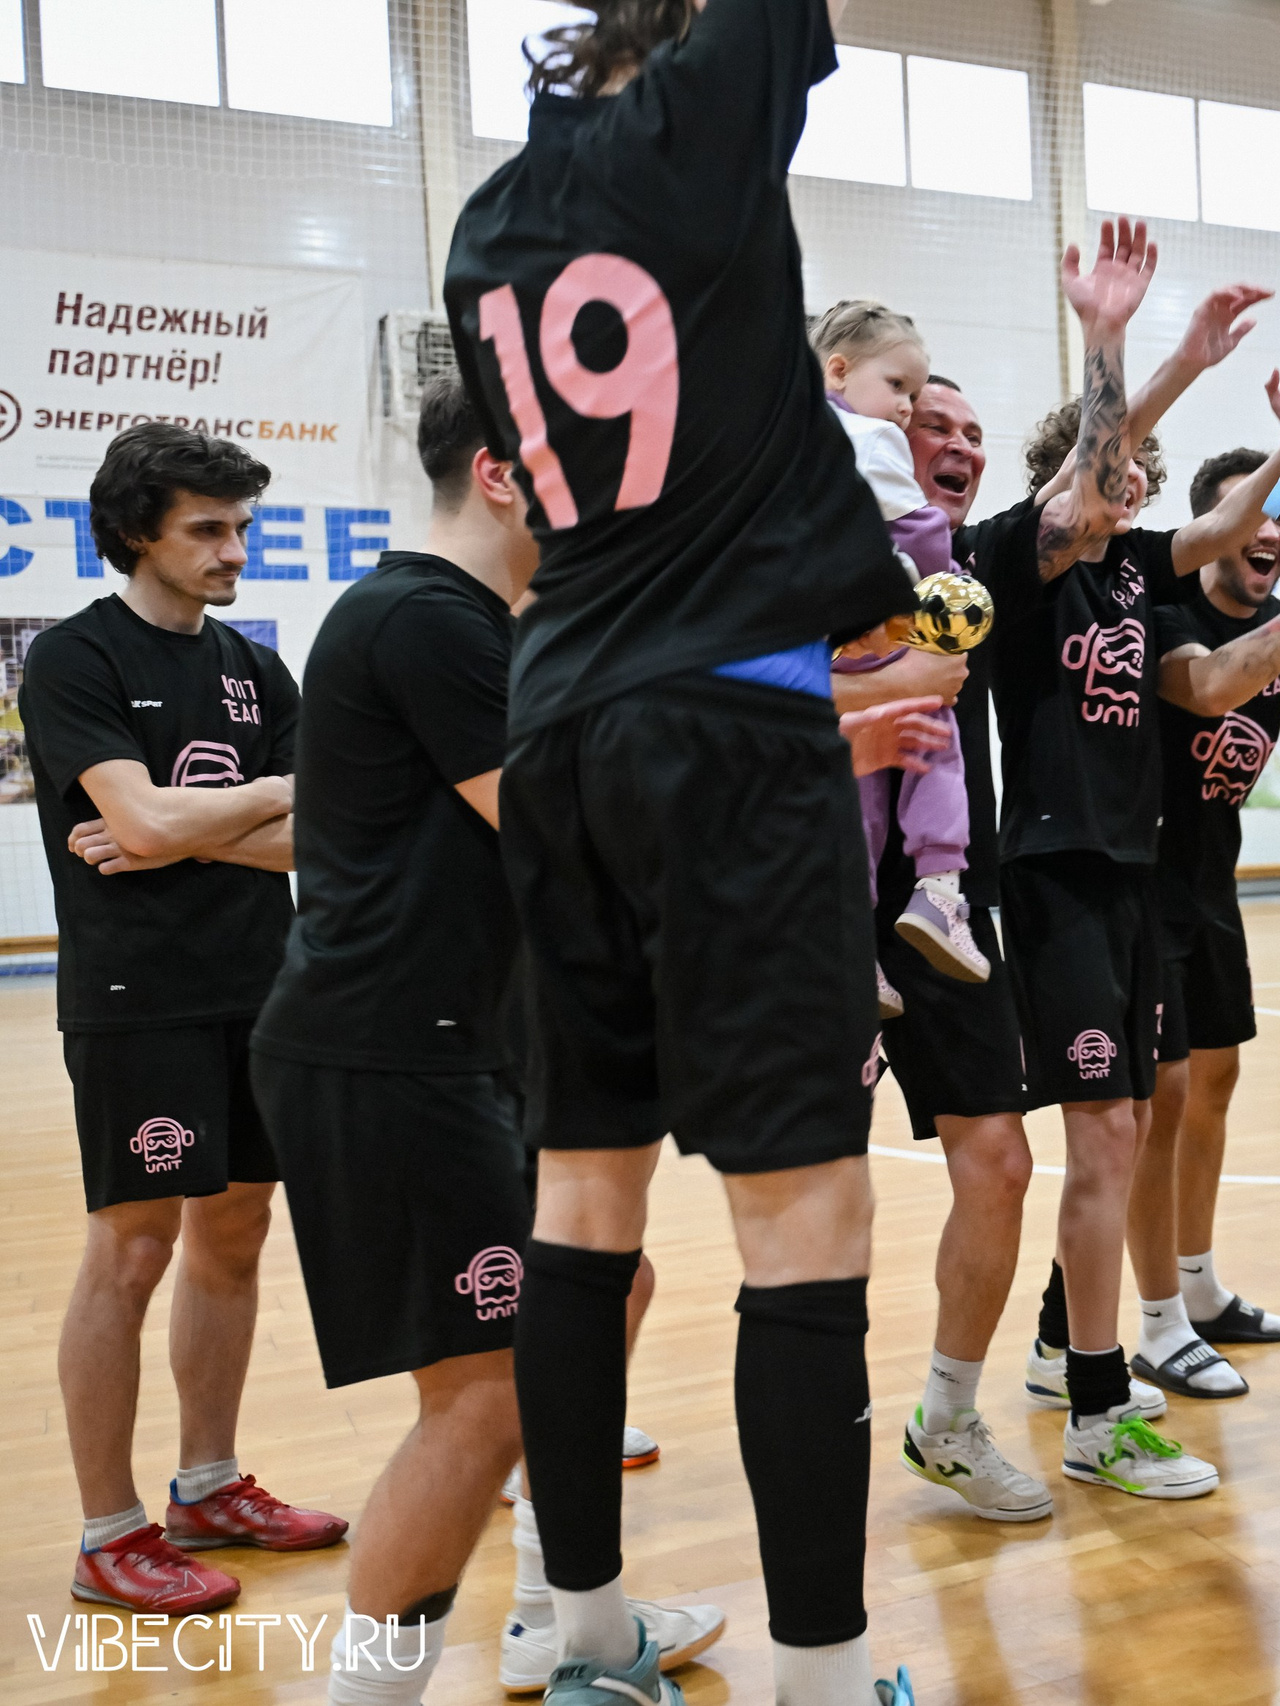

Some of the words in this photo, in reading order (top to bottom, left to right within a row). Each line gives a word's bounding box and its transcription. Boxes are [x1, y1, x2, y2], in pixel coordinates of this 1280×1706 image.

[55, 291, 269, 339] Надежный
[48, 348, 221, 390] партнёр!
[478, 252, 680, 530] 19
[1173, 1344, 1217, 1372] PUM
